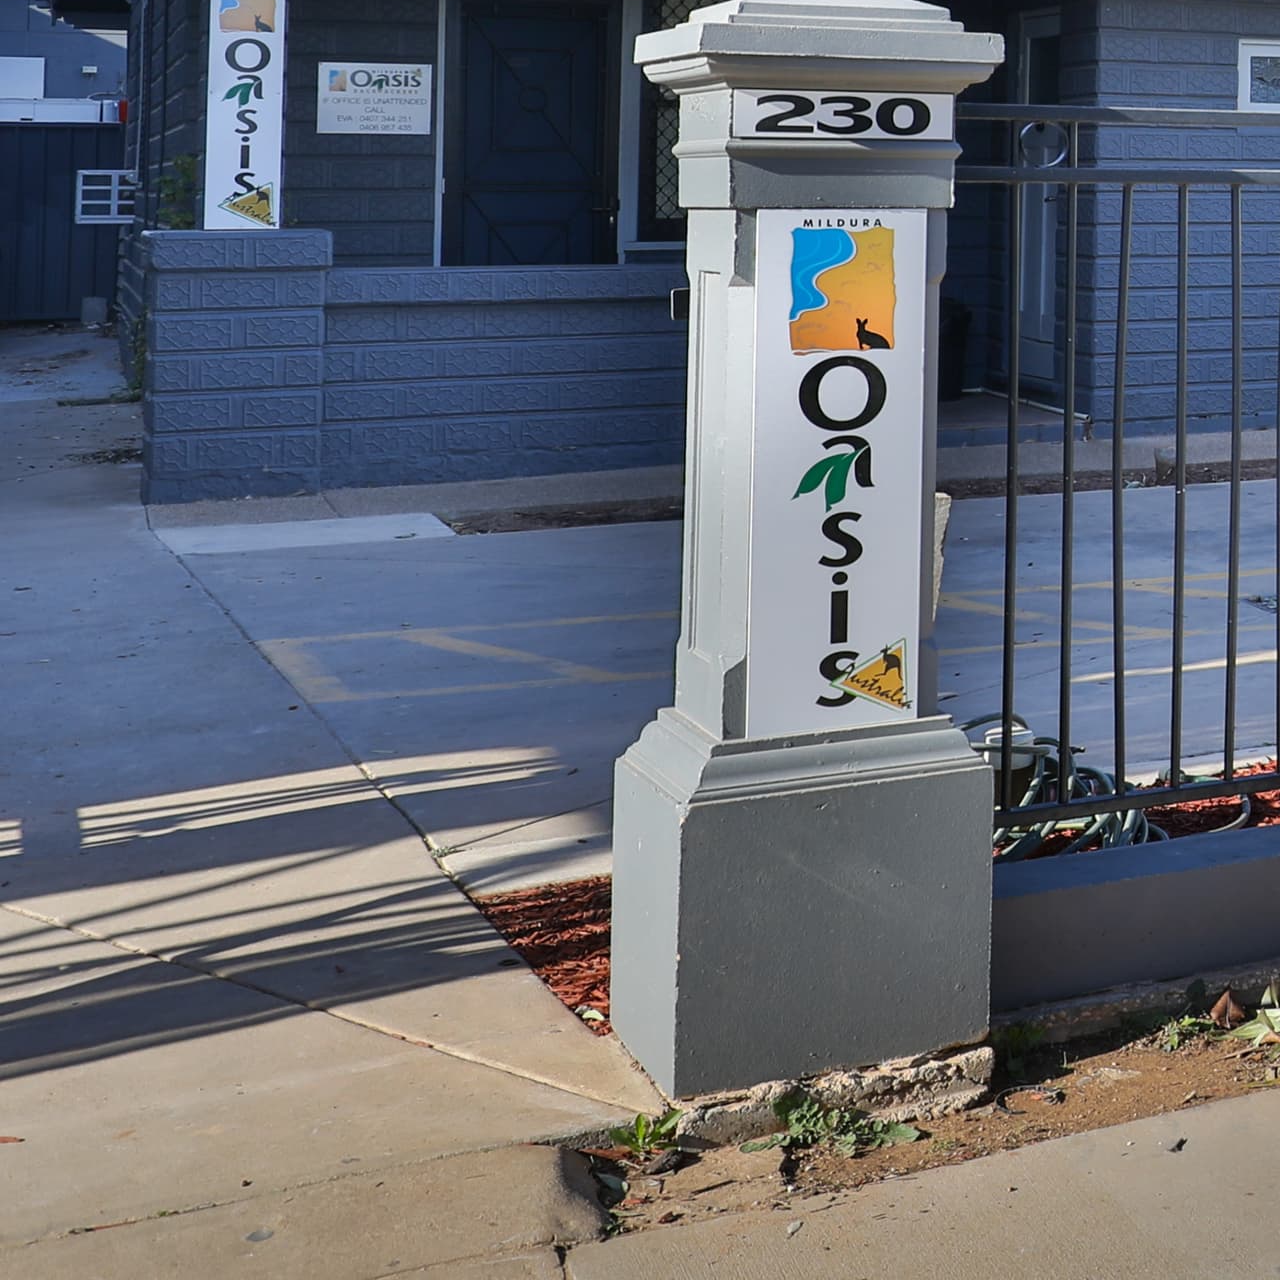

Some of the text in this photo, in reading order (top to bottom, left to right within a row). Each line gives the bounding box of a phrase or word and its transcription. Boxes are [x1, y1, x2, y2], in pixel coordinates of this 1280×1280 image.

[350, 70, 422, 90] Oasis
[373, 97, 427, 105] UNATTENDED
[755, 94, 931, 136] 230
[803, 218, 882, 228] MILDURA
[791, 355, 887, 708] Oasis
